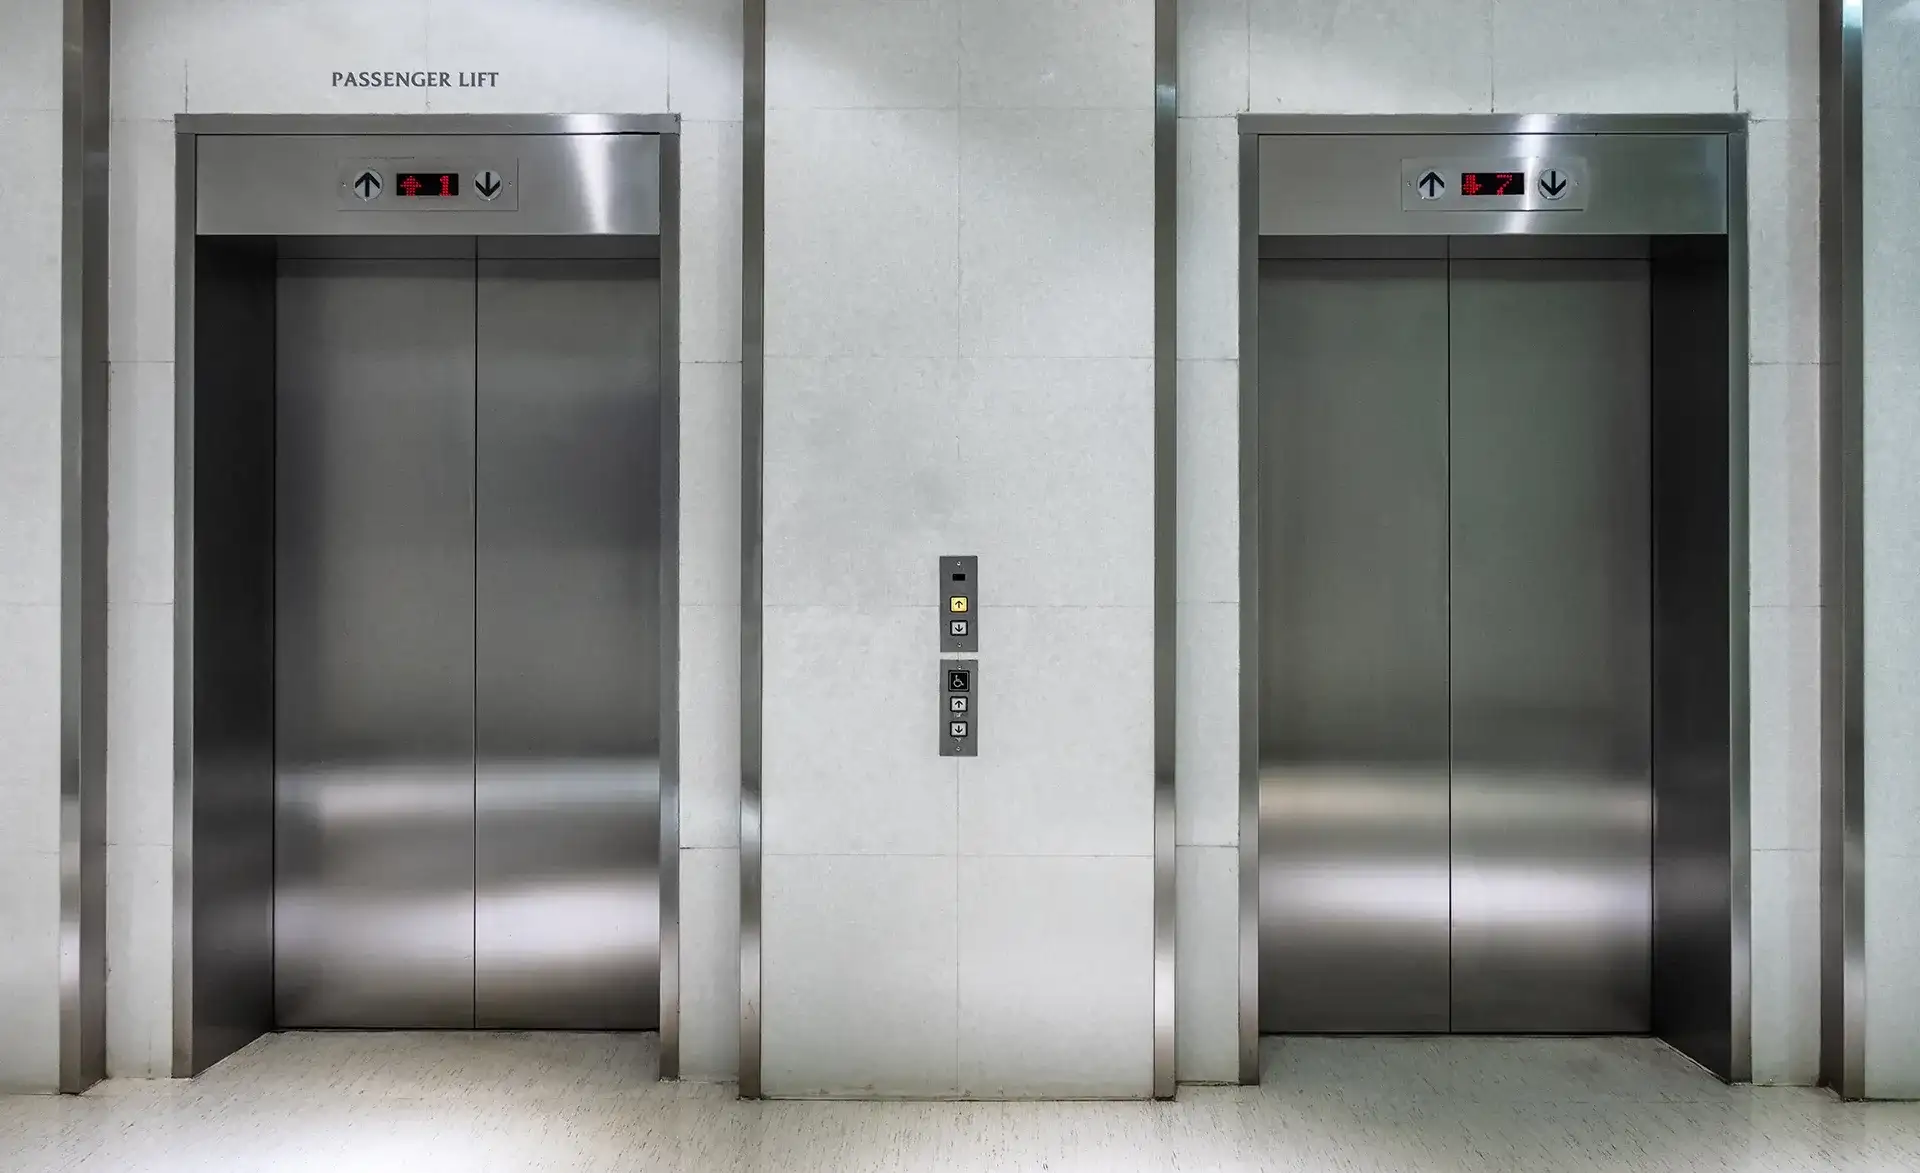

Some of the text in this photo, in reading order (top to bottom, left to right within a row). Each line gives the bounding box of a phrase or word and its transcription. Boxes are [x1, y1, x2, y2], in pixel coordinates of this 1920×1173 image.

[332, 71, 499, 87] PASSENGER LIFT
[439, 175, 452, 196] 1
[1496, 174, 1512, 196] 7
